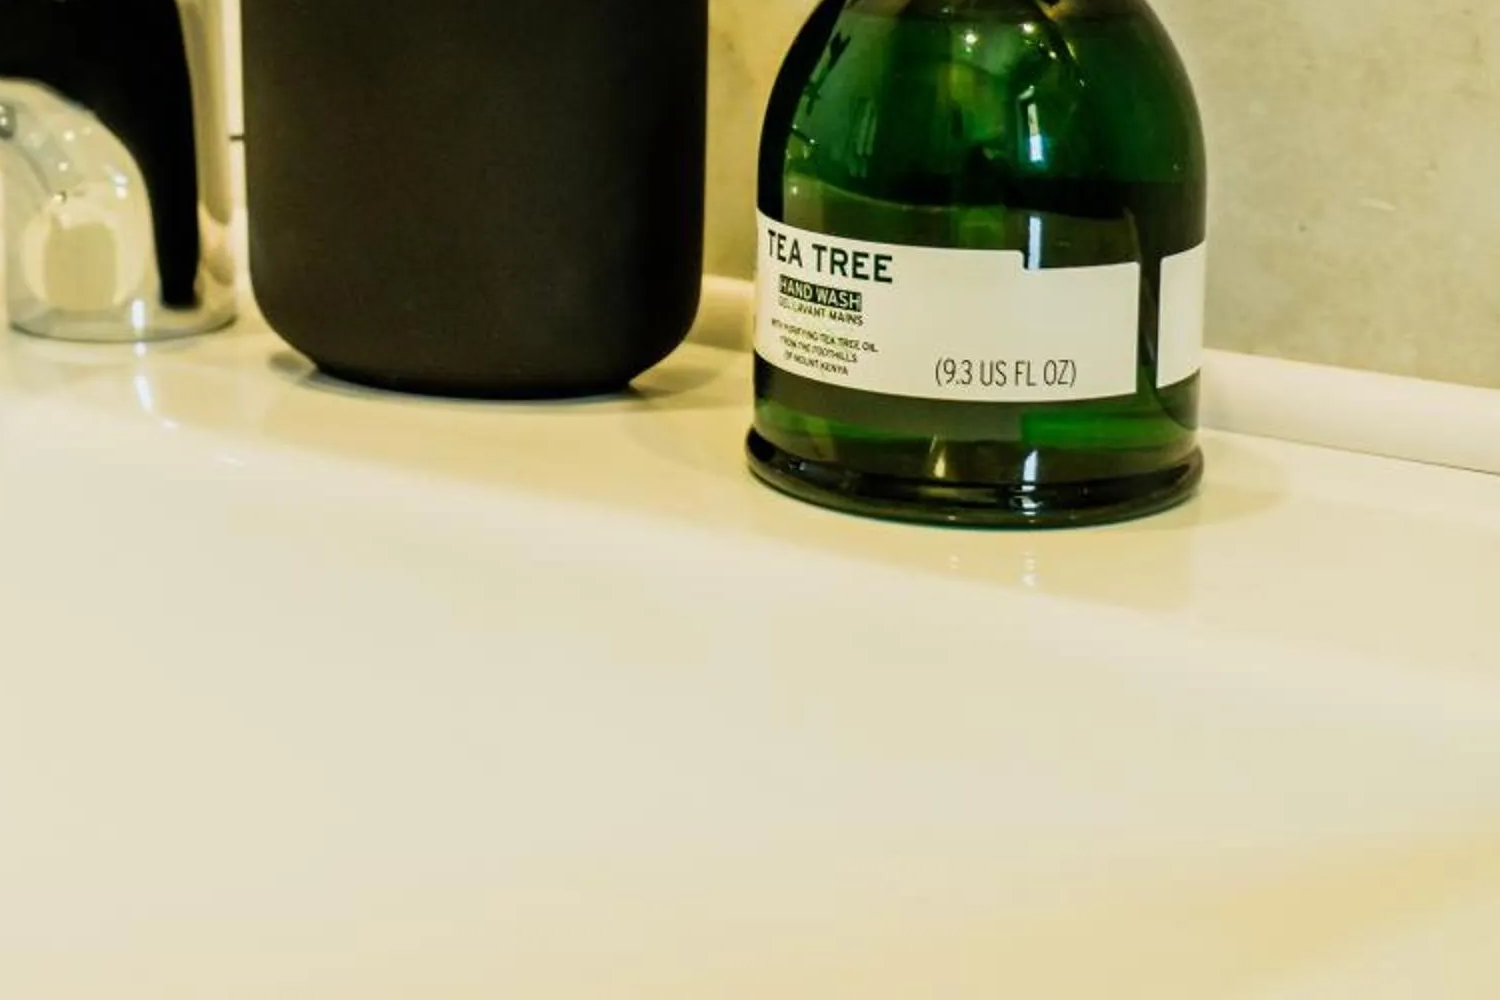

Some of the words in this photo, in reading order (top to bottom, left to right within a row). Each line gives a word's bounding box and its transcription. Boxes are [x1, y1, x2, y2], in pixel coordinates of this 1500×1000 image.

[768, 229, 803, 268] TEA
[812, 243, 892, 284] TREE
[779, 276, 813, 300] HAND
[816, 286, 861, 312] WASH
[829, 310, 864, 326] MAINS
[862, 341, 879, 353] OIL
[935, 357, 972, 387] (9.3
[980, 359, 1007, 387] US
[1015, 359, 1037, 386] FL
[1043, 359, 1077, 388] OZ)
